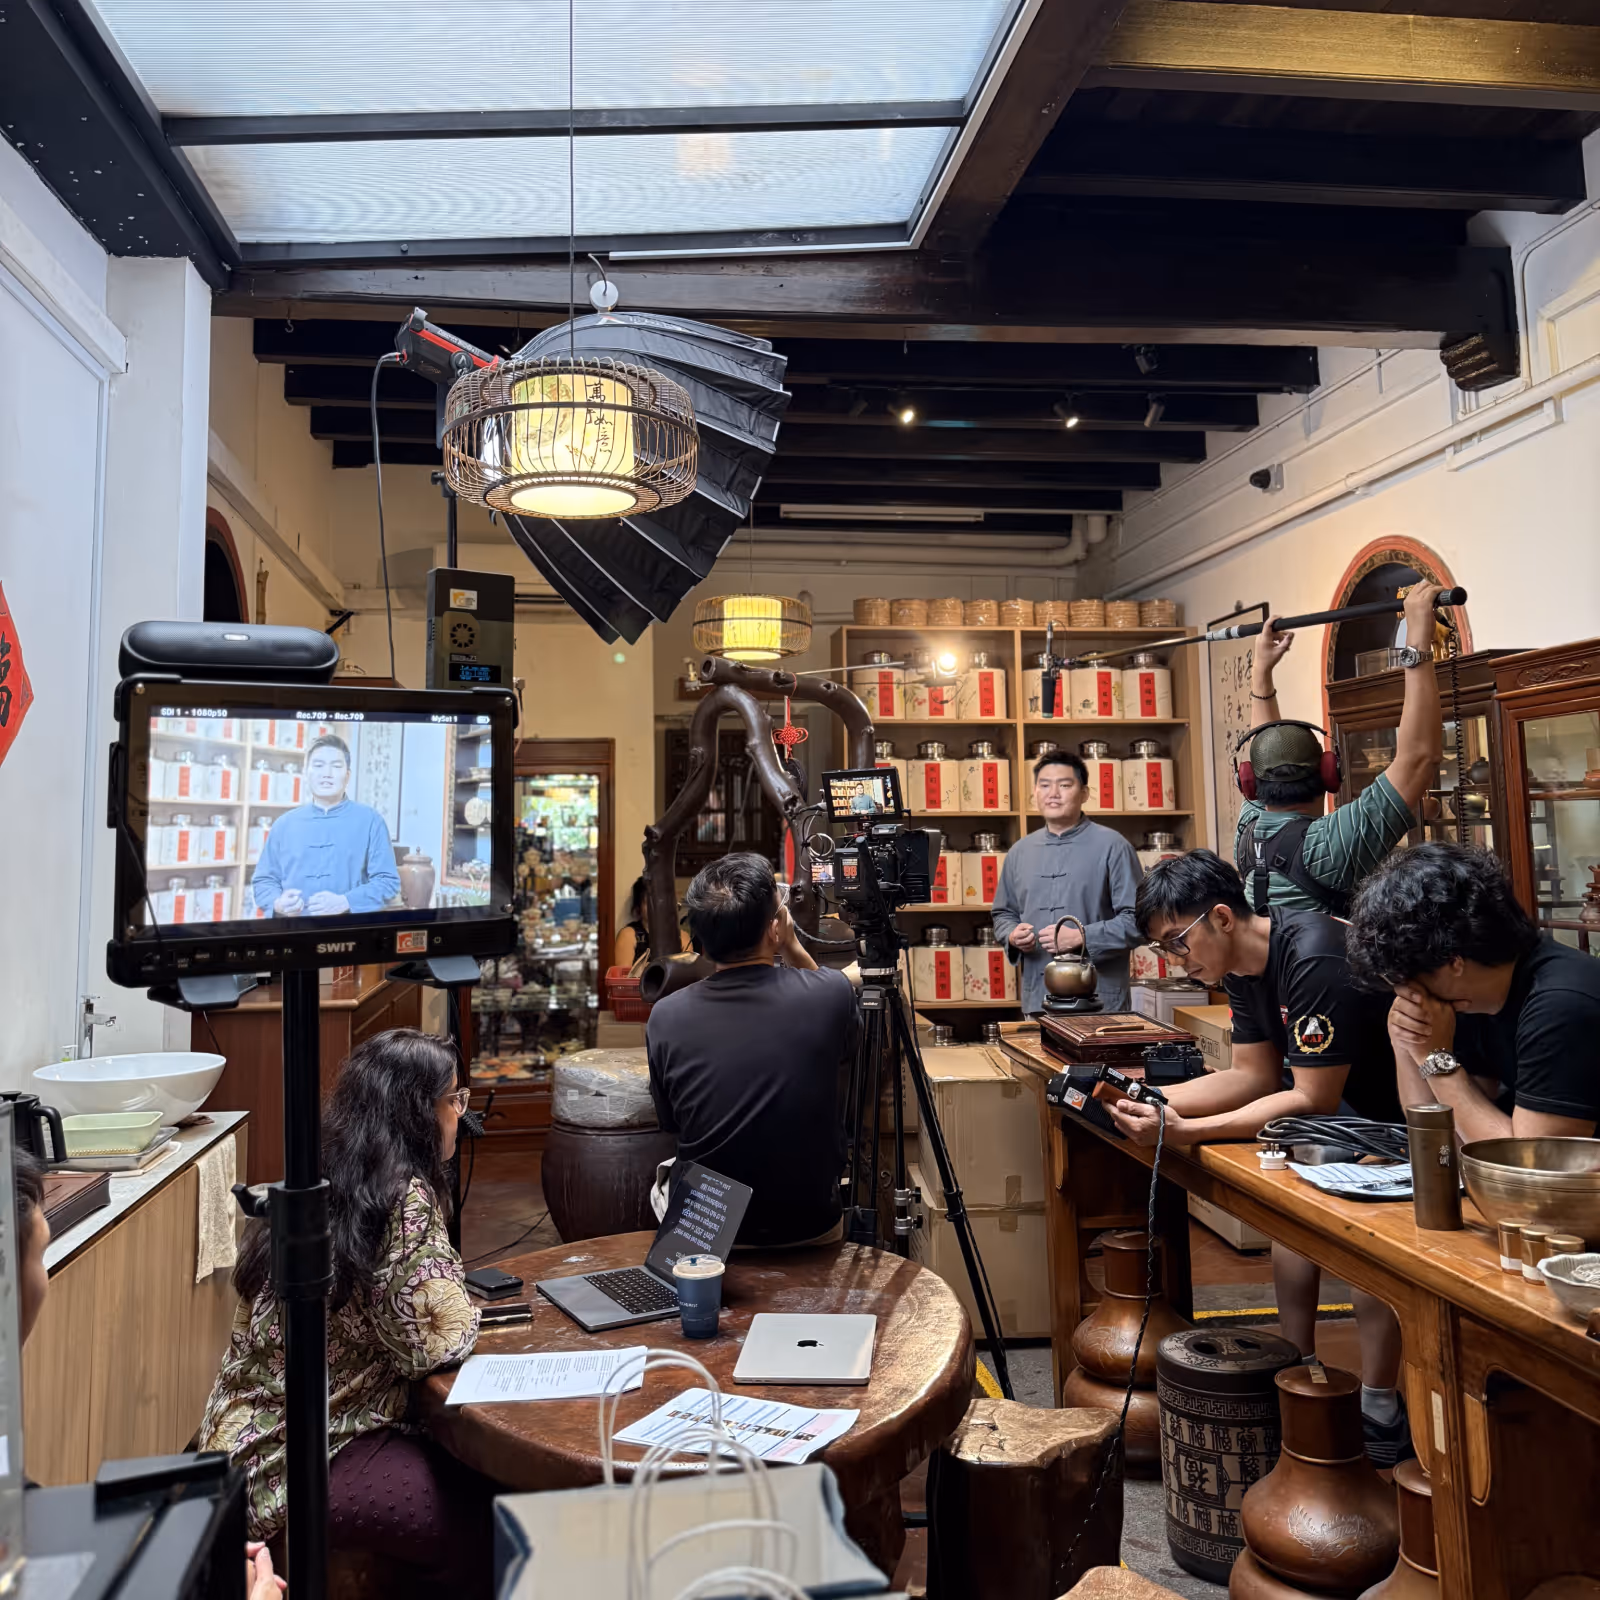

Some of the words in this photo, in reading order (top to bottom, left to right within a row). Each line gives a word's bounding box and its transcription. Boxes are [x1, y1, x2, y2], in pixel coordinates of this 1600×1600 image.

[160, 707, 175, 716] SDI
[296, 711, 327, 720] Rec.709
[334, 712, 364, 721] Rec.709
[317, 942, 356, 953] SWIT
